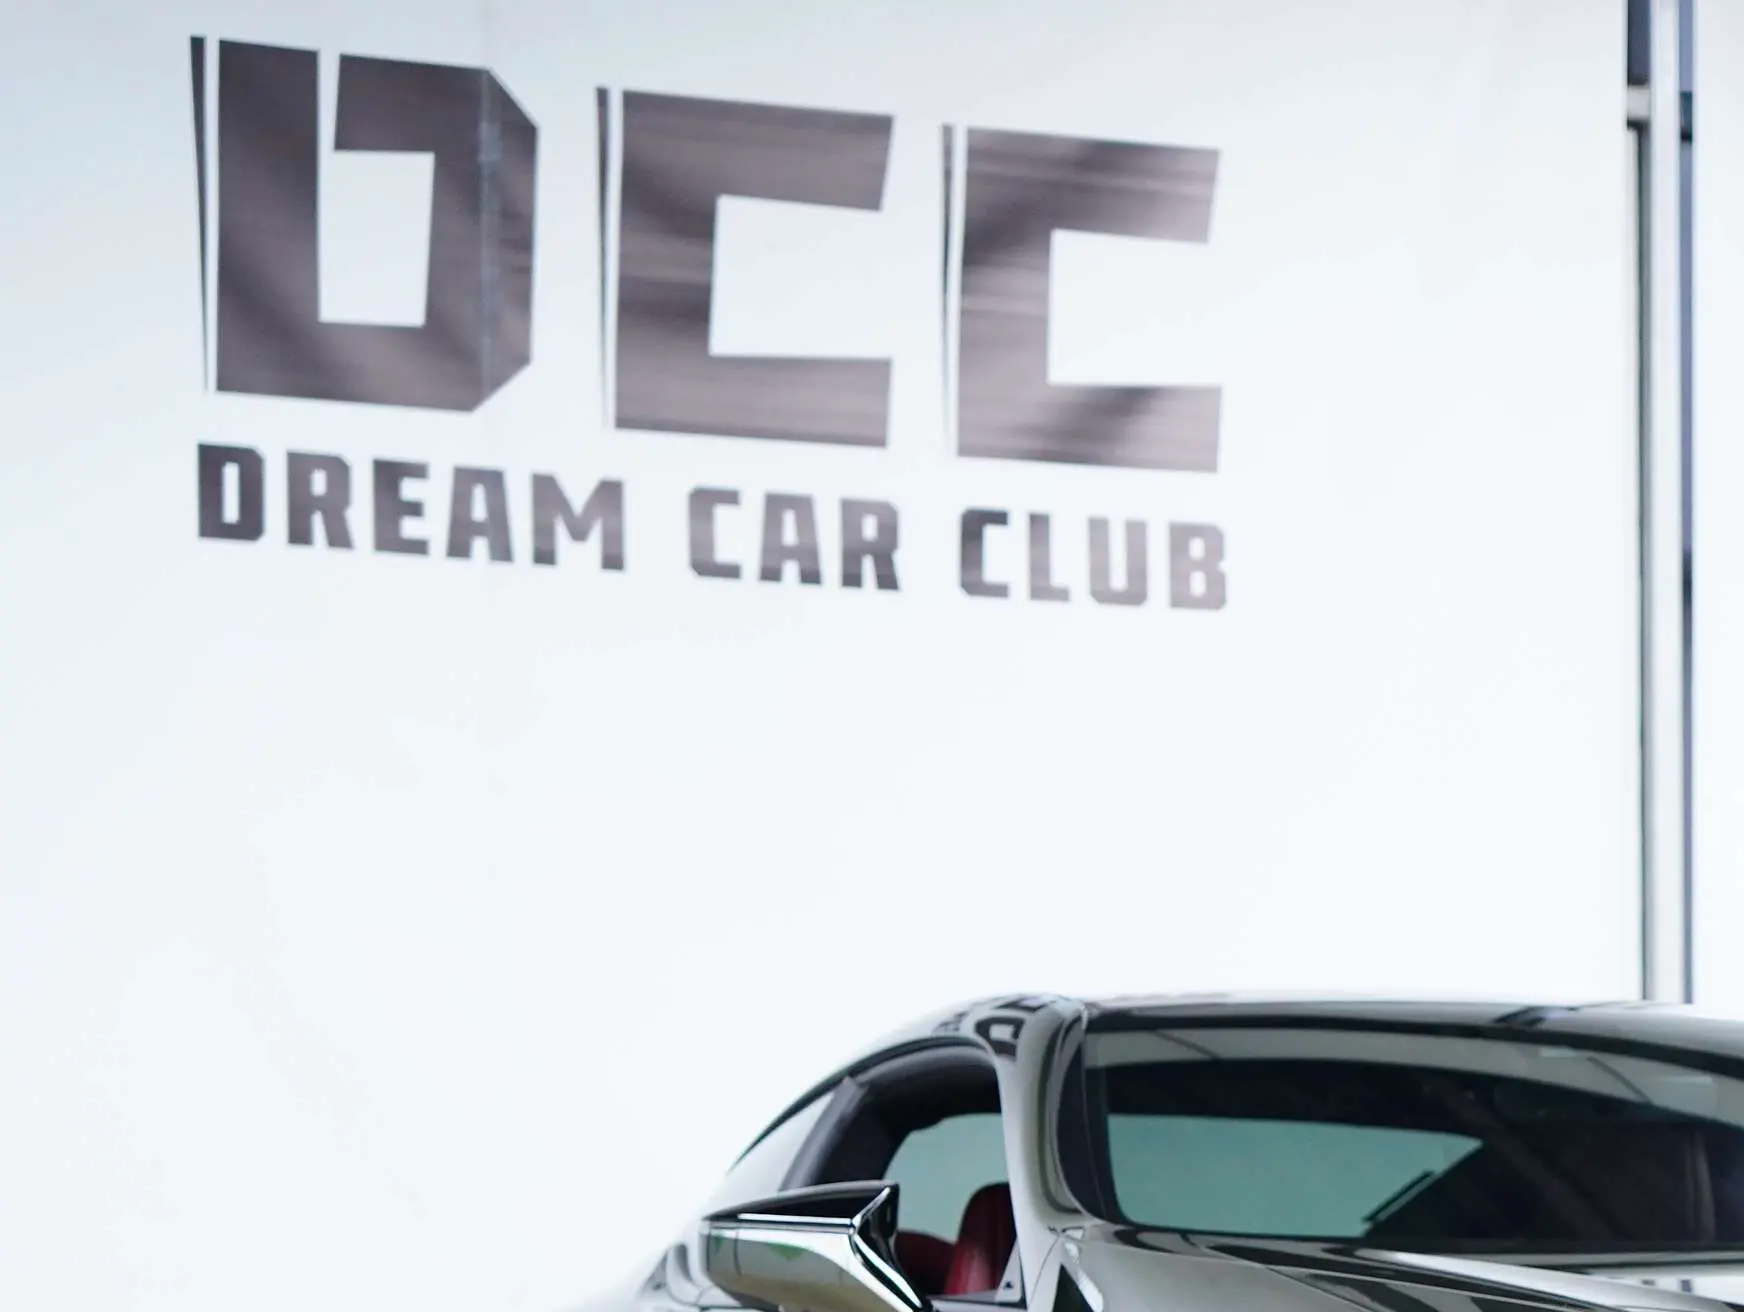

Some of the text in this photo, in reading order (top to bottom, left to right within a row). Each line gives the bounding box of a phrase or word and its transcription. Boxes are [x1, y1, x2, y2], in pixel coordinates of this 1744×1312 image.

[187, 33, 1221, 470] DCC
[196, 441, 1228, 611] DREAM CAR CLUB
